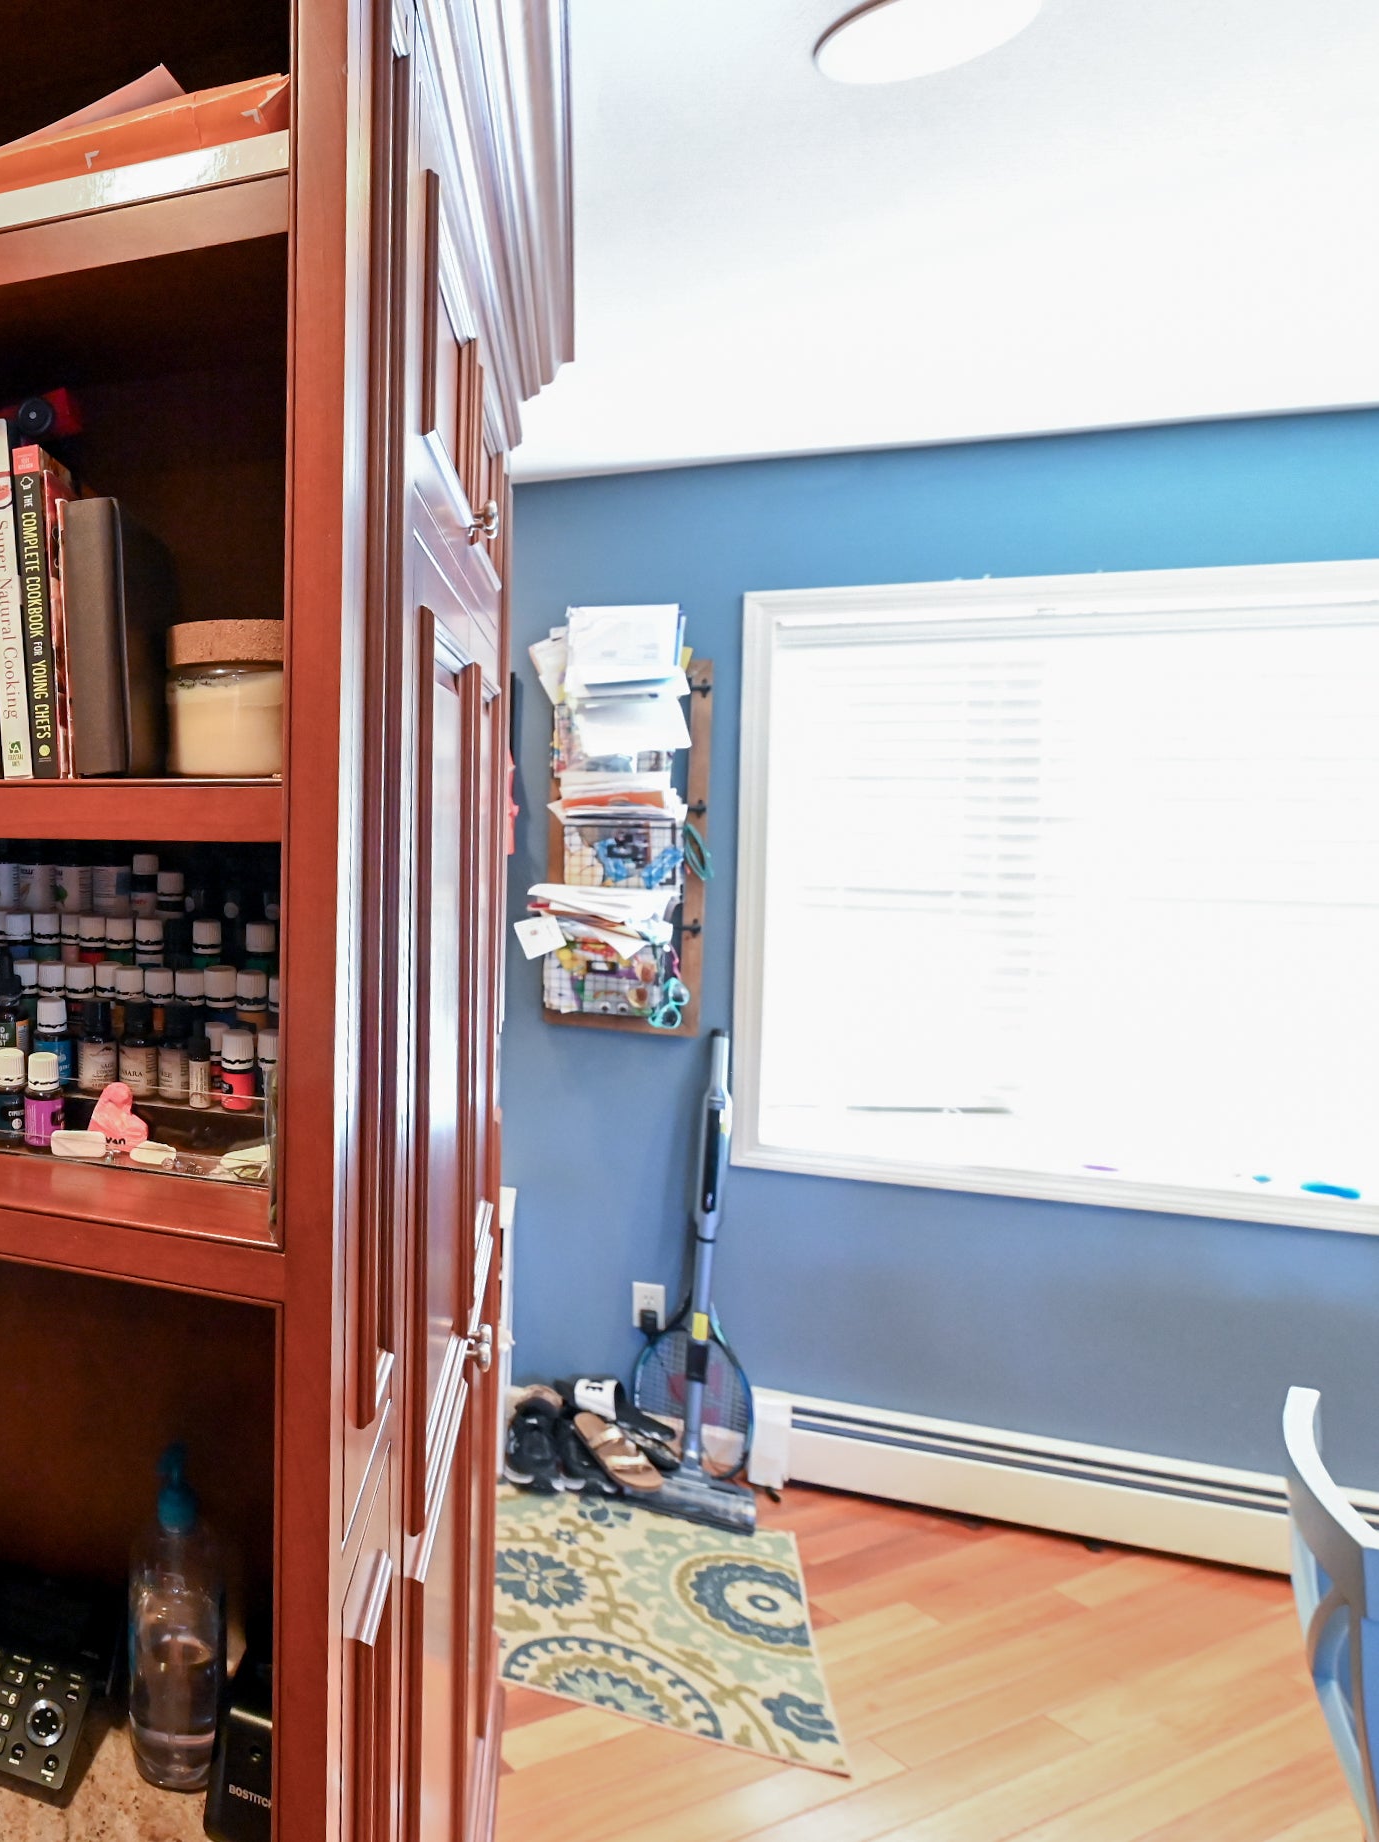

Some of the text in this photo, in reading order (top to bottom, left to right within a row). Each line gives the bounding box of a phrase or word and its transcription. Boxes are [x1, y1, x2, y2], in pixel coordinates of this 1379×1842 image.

[23, 494, 34, 507] THE
[21, 512, 40, 573] COMPLETE
[25, 574, 44, 638] COOKBOOK
[33, 641, 43, 657] FOR
[3, 647, 20, 720] Cooking
[31, 660, 49, 700] YOUNG
[34, 703, 52, 739] CHEFS
[15, 1672, 24, 1683] 3
[8, 1693, 17, 1705] 6
[0, 1714, 9, 1726] 9
